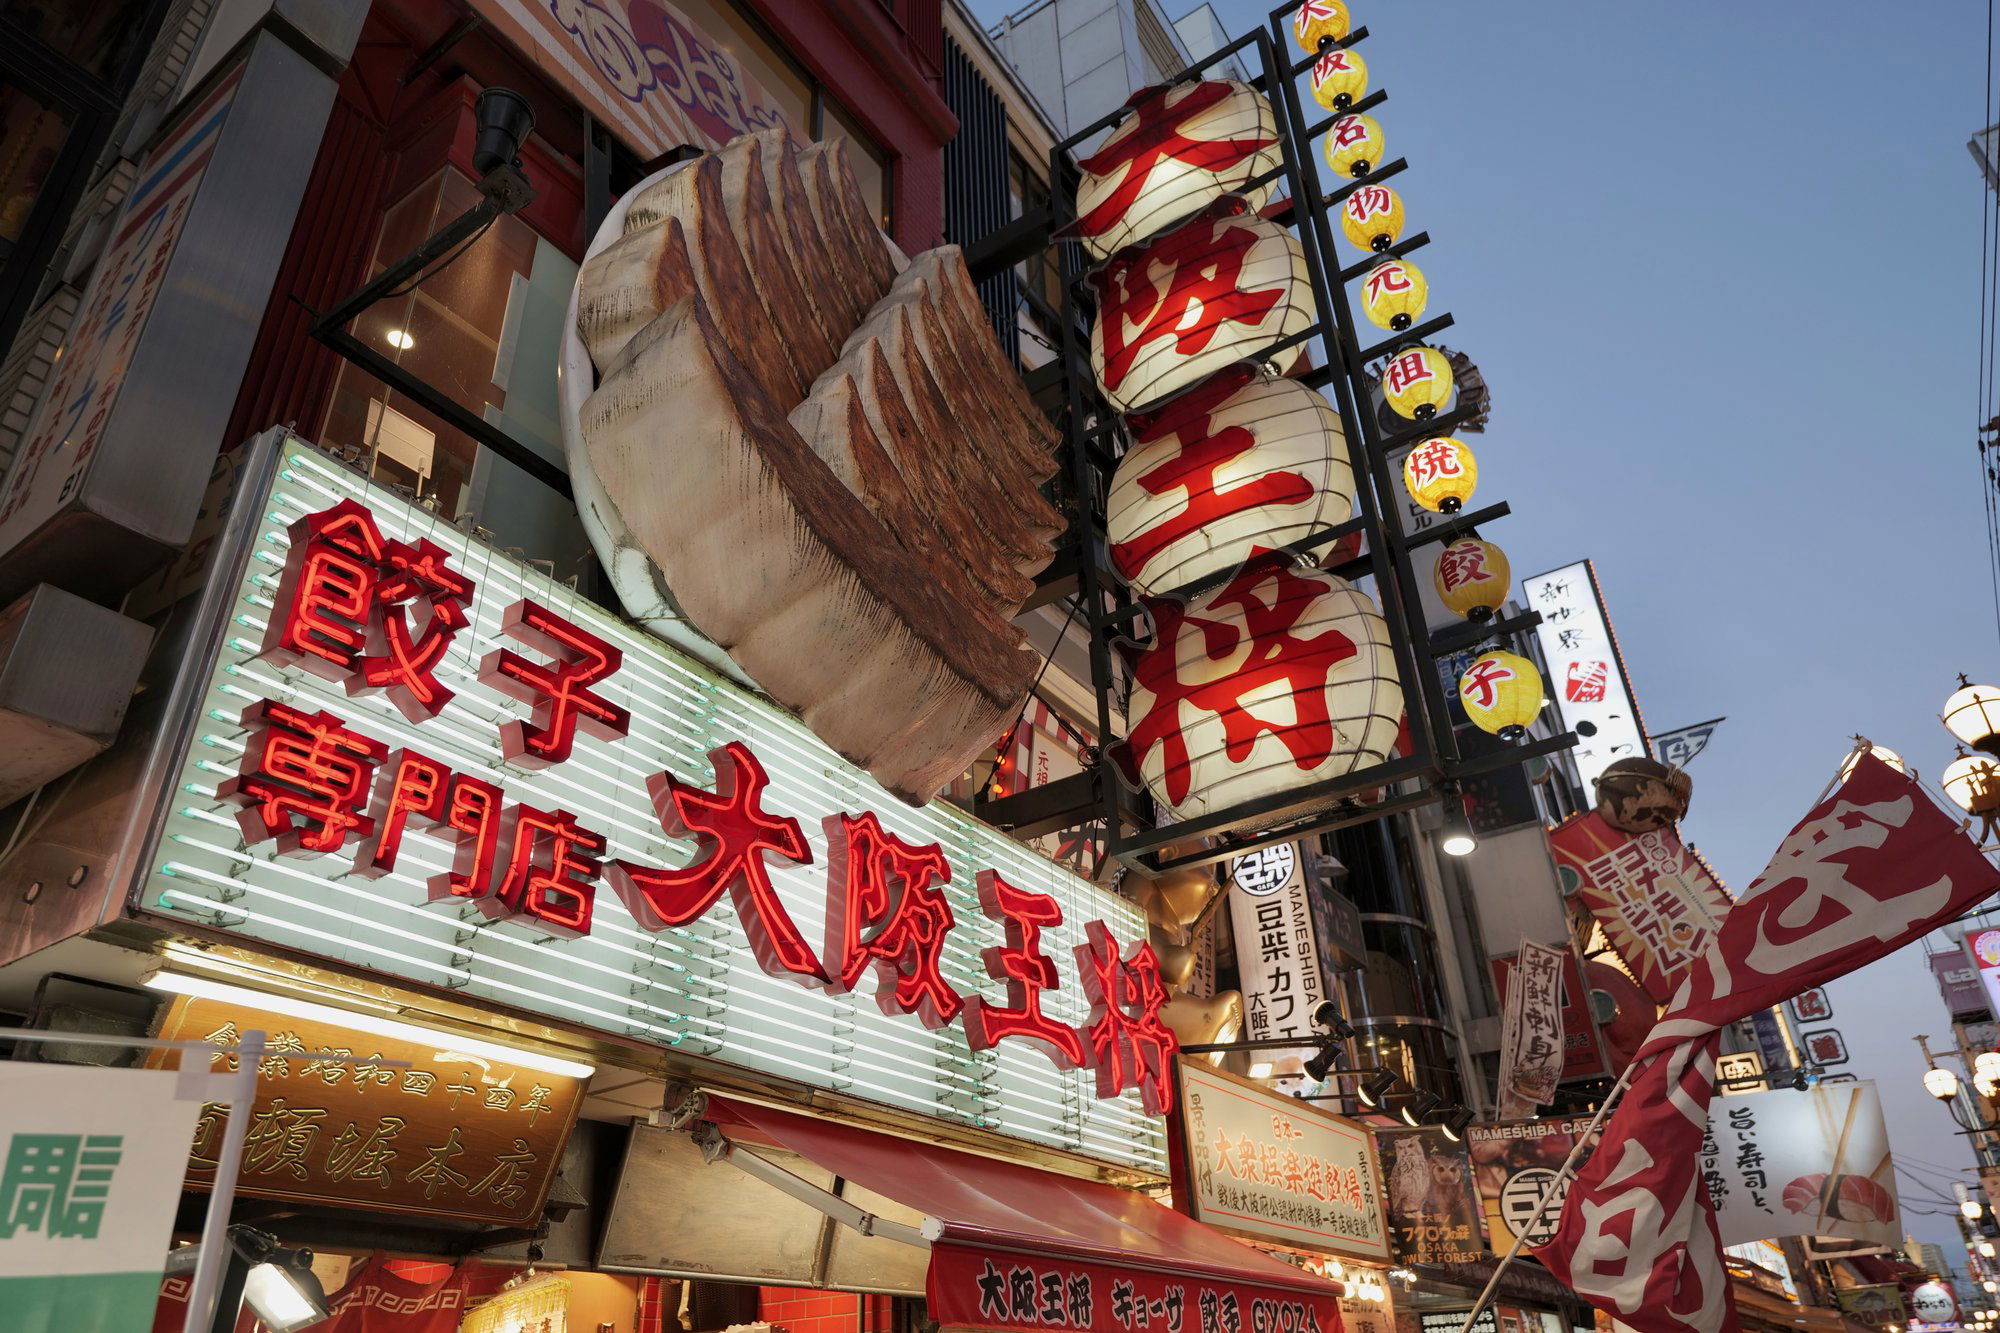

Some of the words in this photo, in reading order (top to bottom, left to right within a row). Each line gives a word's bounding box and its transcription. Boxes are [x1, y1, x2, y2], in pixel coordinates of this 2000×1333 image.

[58, 466, 84, 504] B1
[262, 498, 631, 769] 餃子
[214, 697, 607, 942] 専門店
[603, 741, 1181, 1116] 大阪王将
[1289, 884, 1318, 1006] MAMESHIBA
[1189, 1093, 1213, 1197] 景品付
[1271, 1113, 1304, 1141] 日本一
[1471, 1124, 1558, 1141] MAMESHIBA
[1214, 1127, 1364, 1212] 大衆娯楽遊戯場
[1358, 1151, 1380, 1235] 景品付
[1417, 1241, 1459, 1253] OSAKA
[1436, 1250, 1483, 1264] FOREST
[977, 1259, 1093, 1328] 大阪王将
[1112, 1278, 1184, 1333] ギョーザ
[1251, 1297, 1322, 1333] GYOZA
